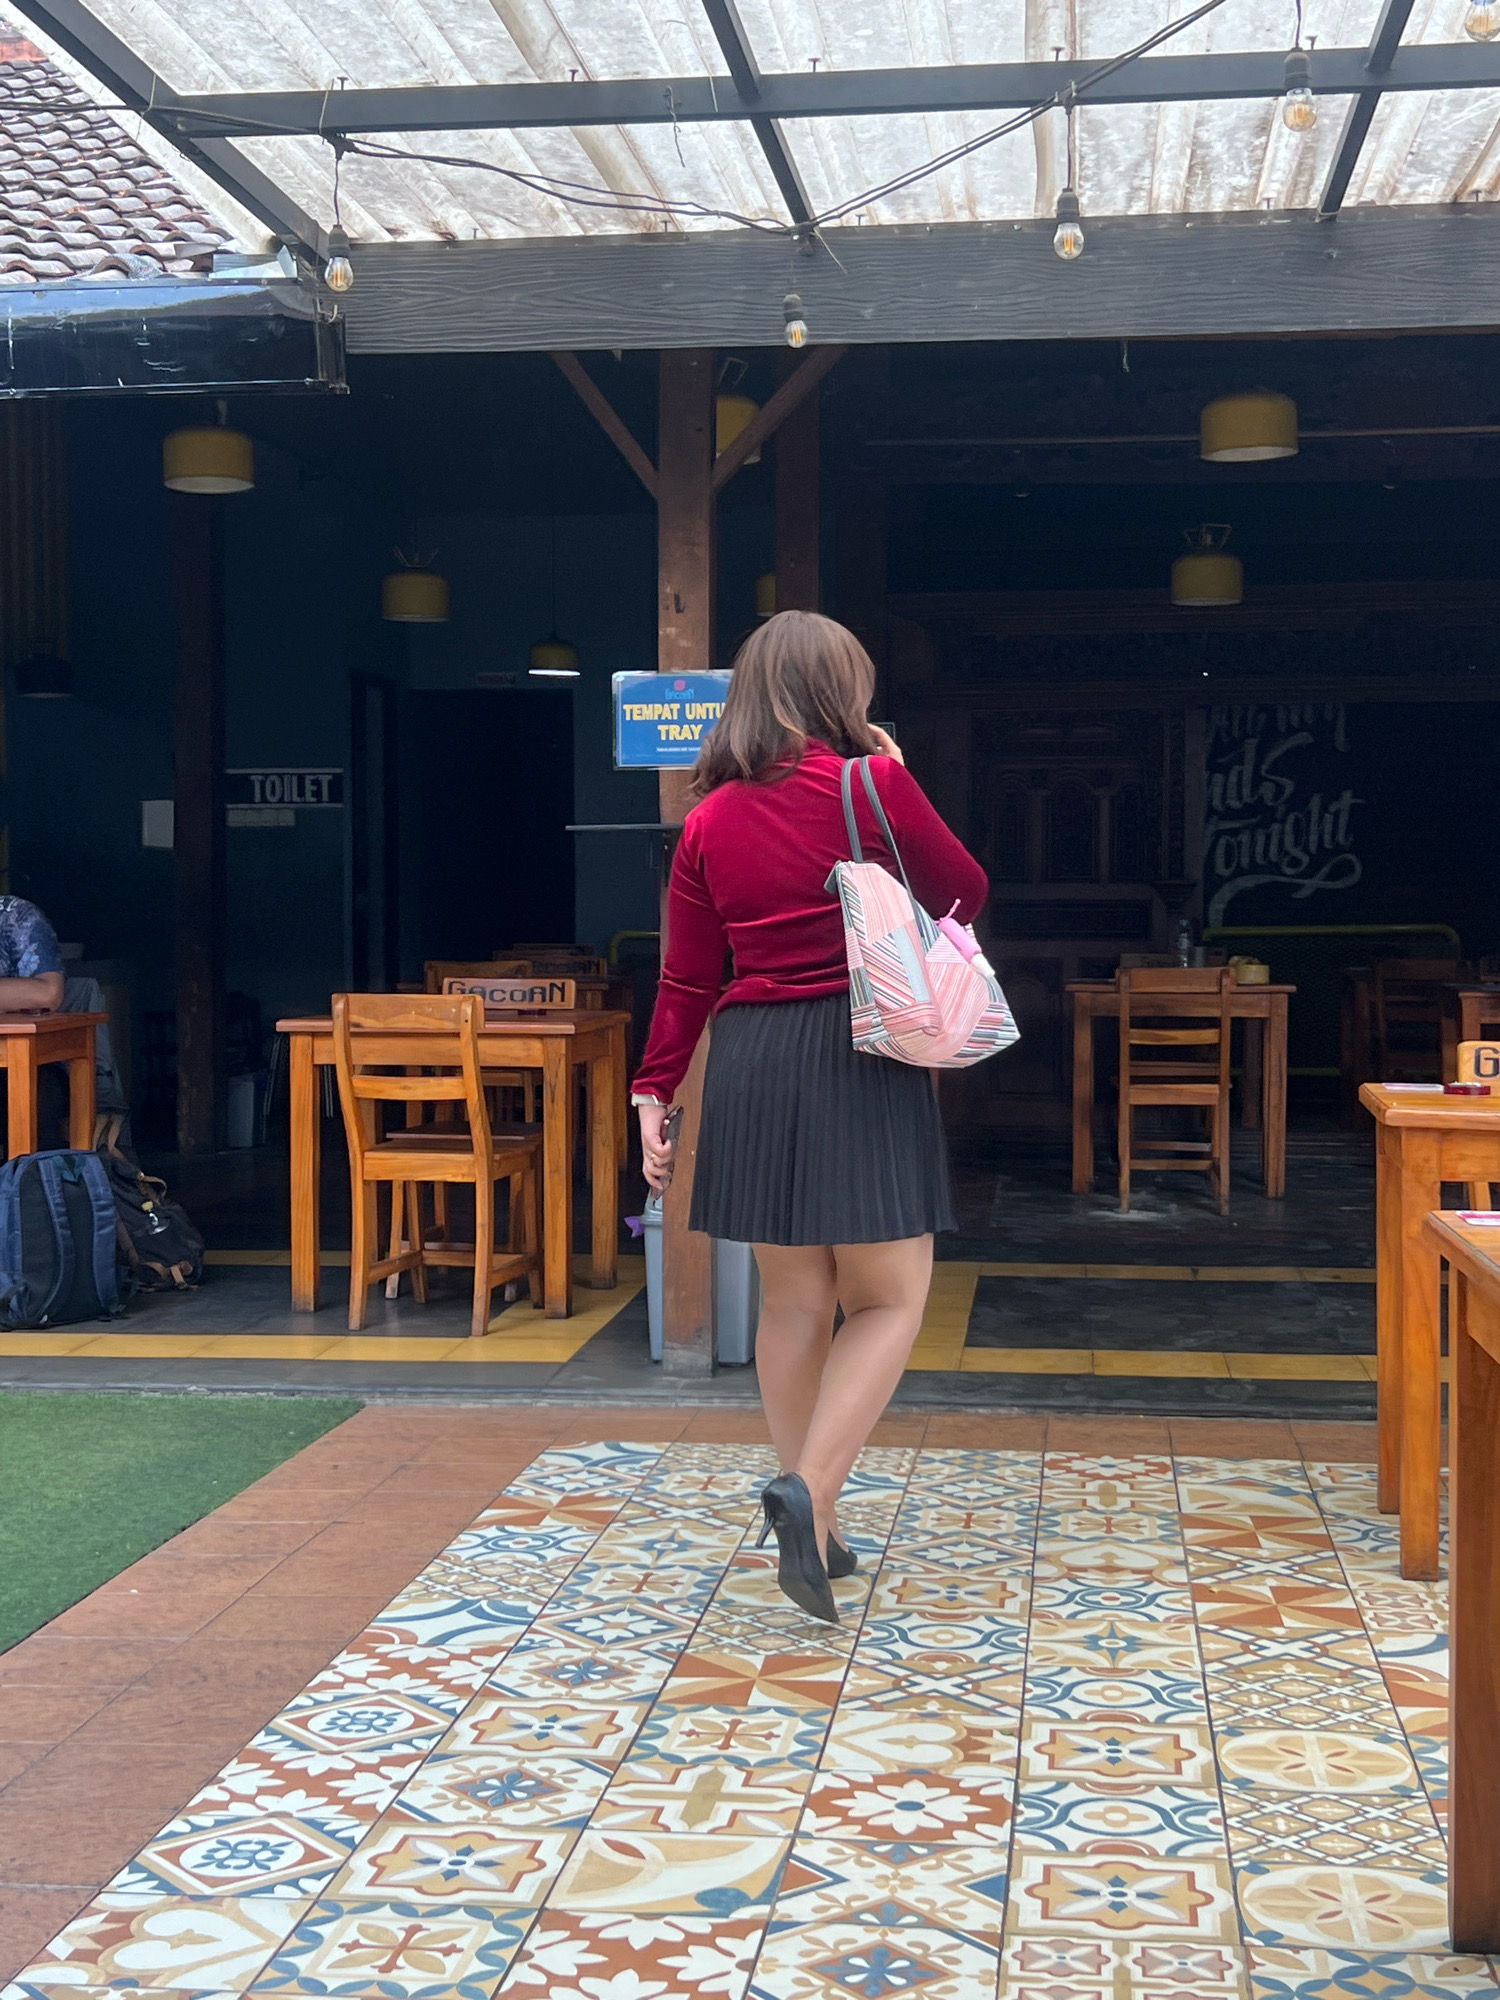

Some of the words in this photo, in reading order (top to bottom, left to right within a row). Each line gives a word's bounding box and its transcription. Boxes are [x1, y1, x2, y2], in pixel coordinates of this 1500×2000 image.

[623, 703, 680, 720] TEMPAT
[685, 703, 726, 720] UNTU
[657, 724, 703, 740] TRAY
[250, 775, 333, 803] TOILET
